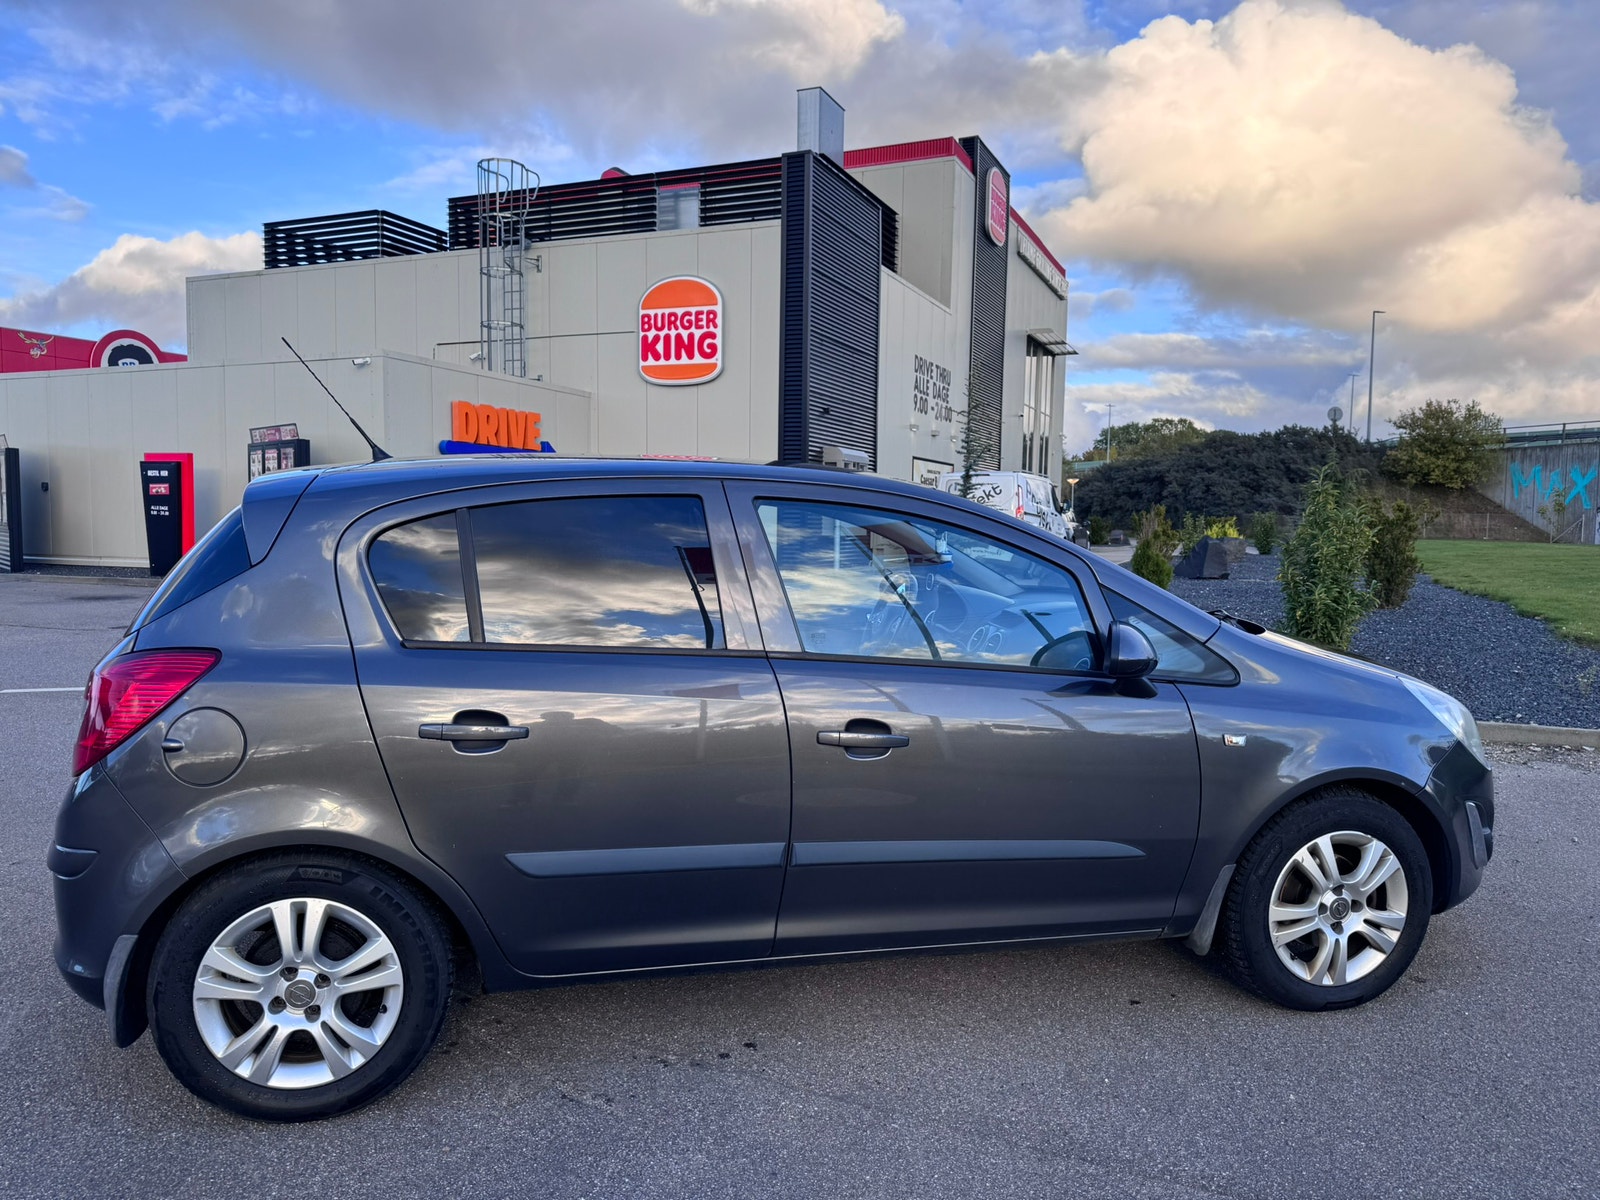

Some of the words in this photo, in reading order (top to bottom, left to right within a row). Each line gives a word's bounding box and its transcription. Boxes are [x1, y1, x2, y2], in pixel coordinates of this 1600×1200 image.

[641, 309, 718, 333] BURGER
[641, 331, 718, 362] KING
[914, 354, 934, 380] DRIVE
[935, 364, 952, 387] THRU
[913, 393, 929, 416] 9.00
[914, 374, 930, 397] ALLE
[932, 381, 950, 404] DAGE
[451, 400, 541, 451] DRIVE
[1510, 461, 1598, 510] MAX
